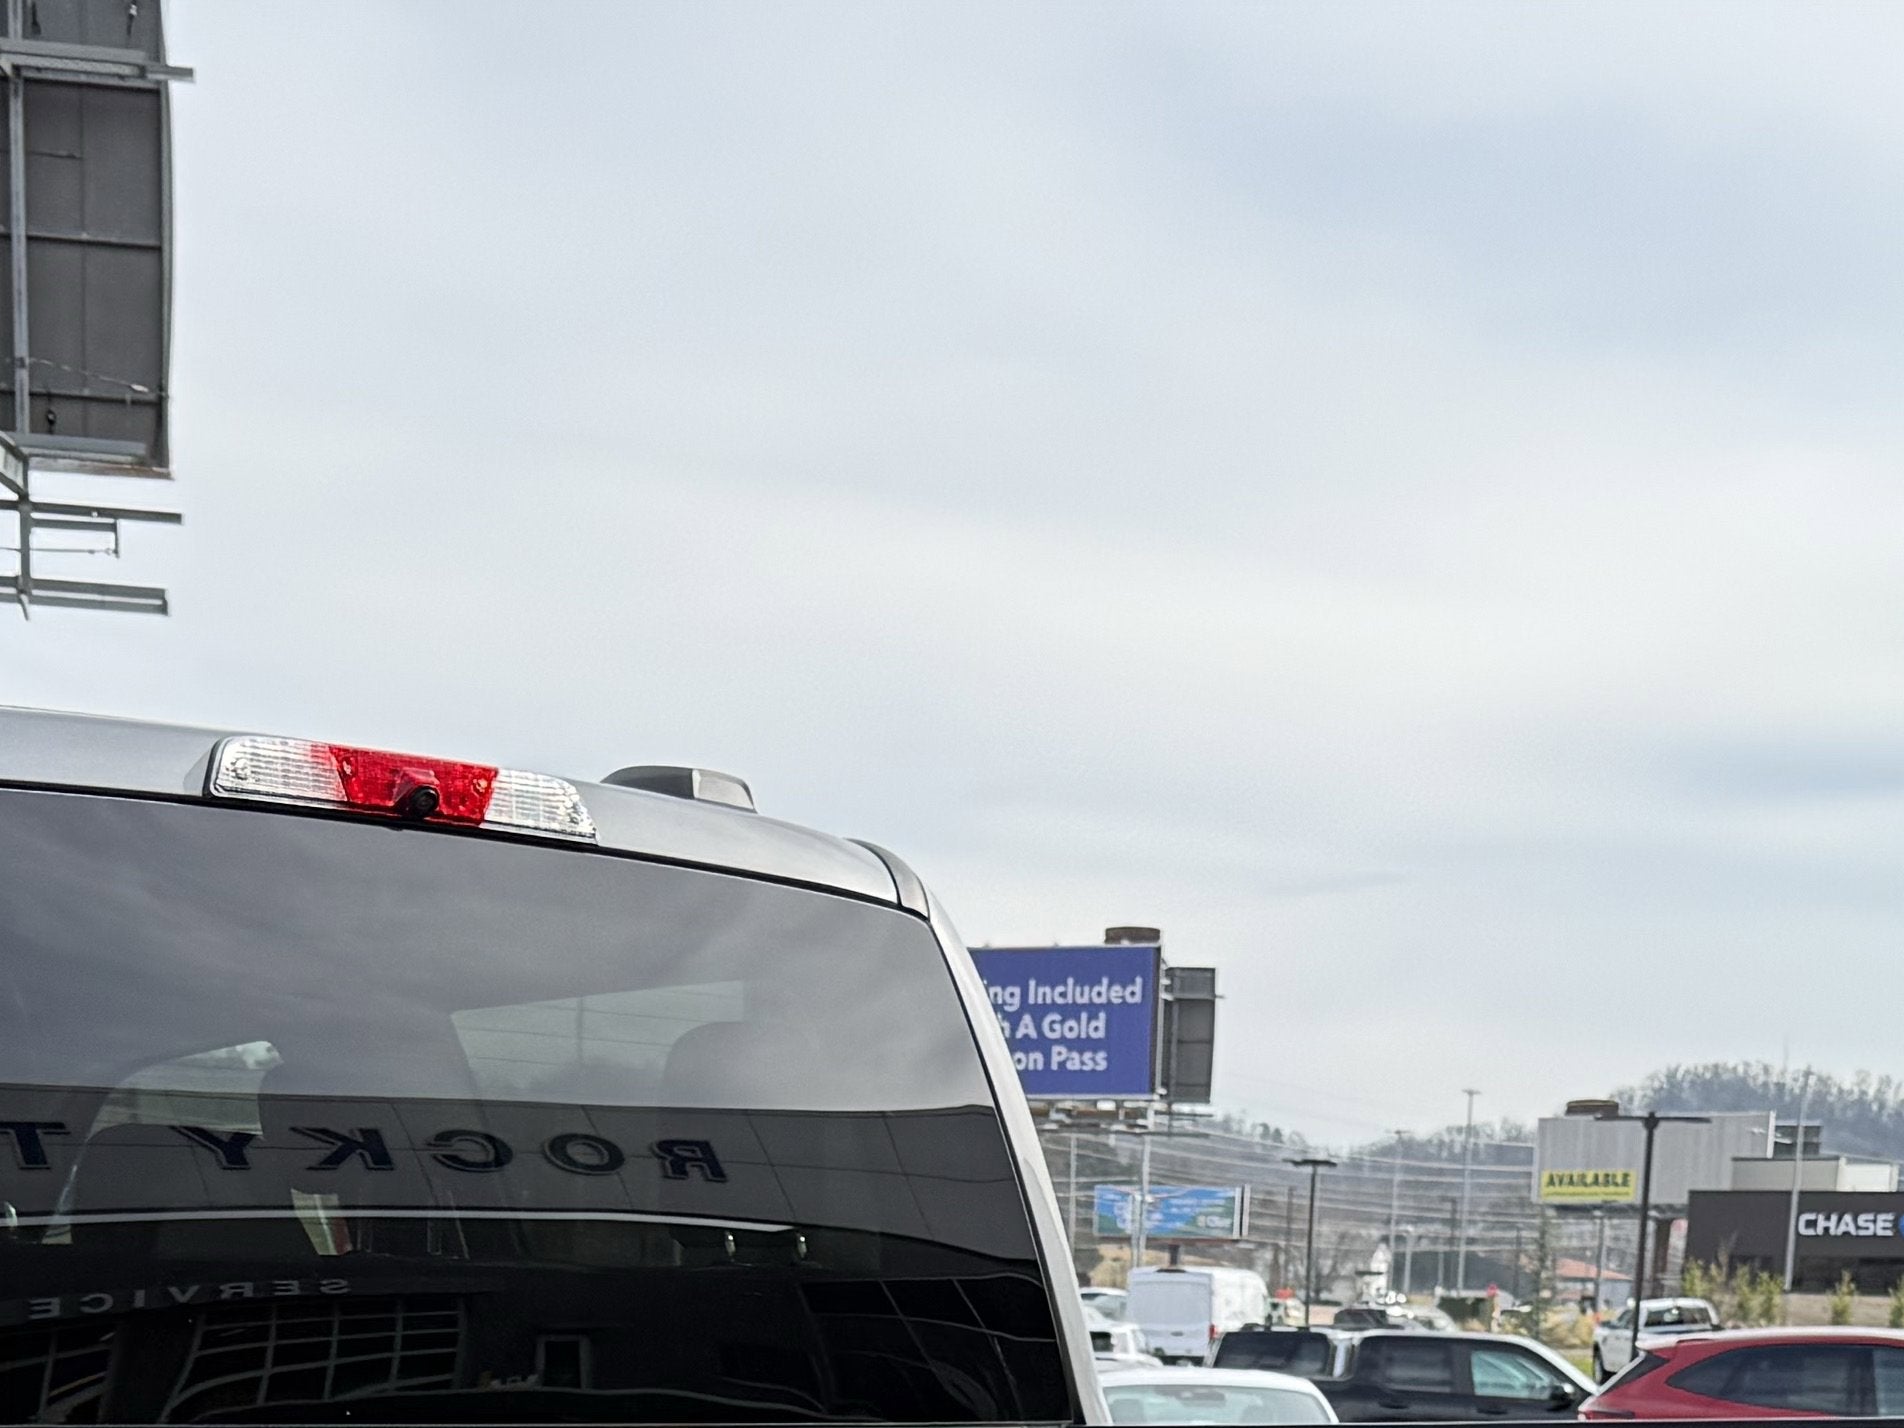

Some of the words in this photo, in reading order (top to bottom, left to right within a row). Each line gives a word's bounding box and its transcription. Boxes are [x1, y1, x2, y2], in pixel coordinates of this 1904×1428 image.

[984, 979, 1021, 1012] ng
[1028, 976, 1143, 1005] Included
[1015, 1013, 1038, 1040] A
[1041, 1011, 1107, 1039] Gold
[1050, 1045, 1108, 1071] Pass
[1797, 1212, 1895, 1237] CHASE
